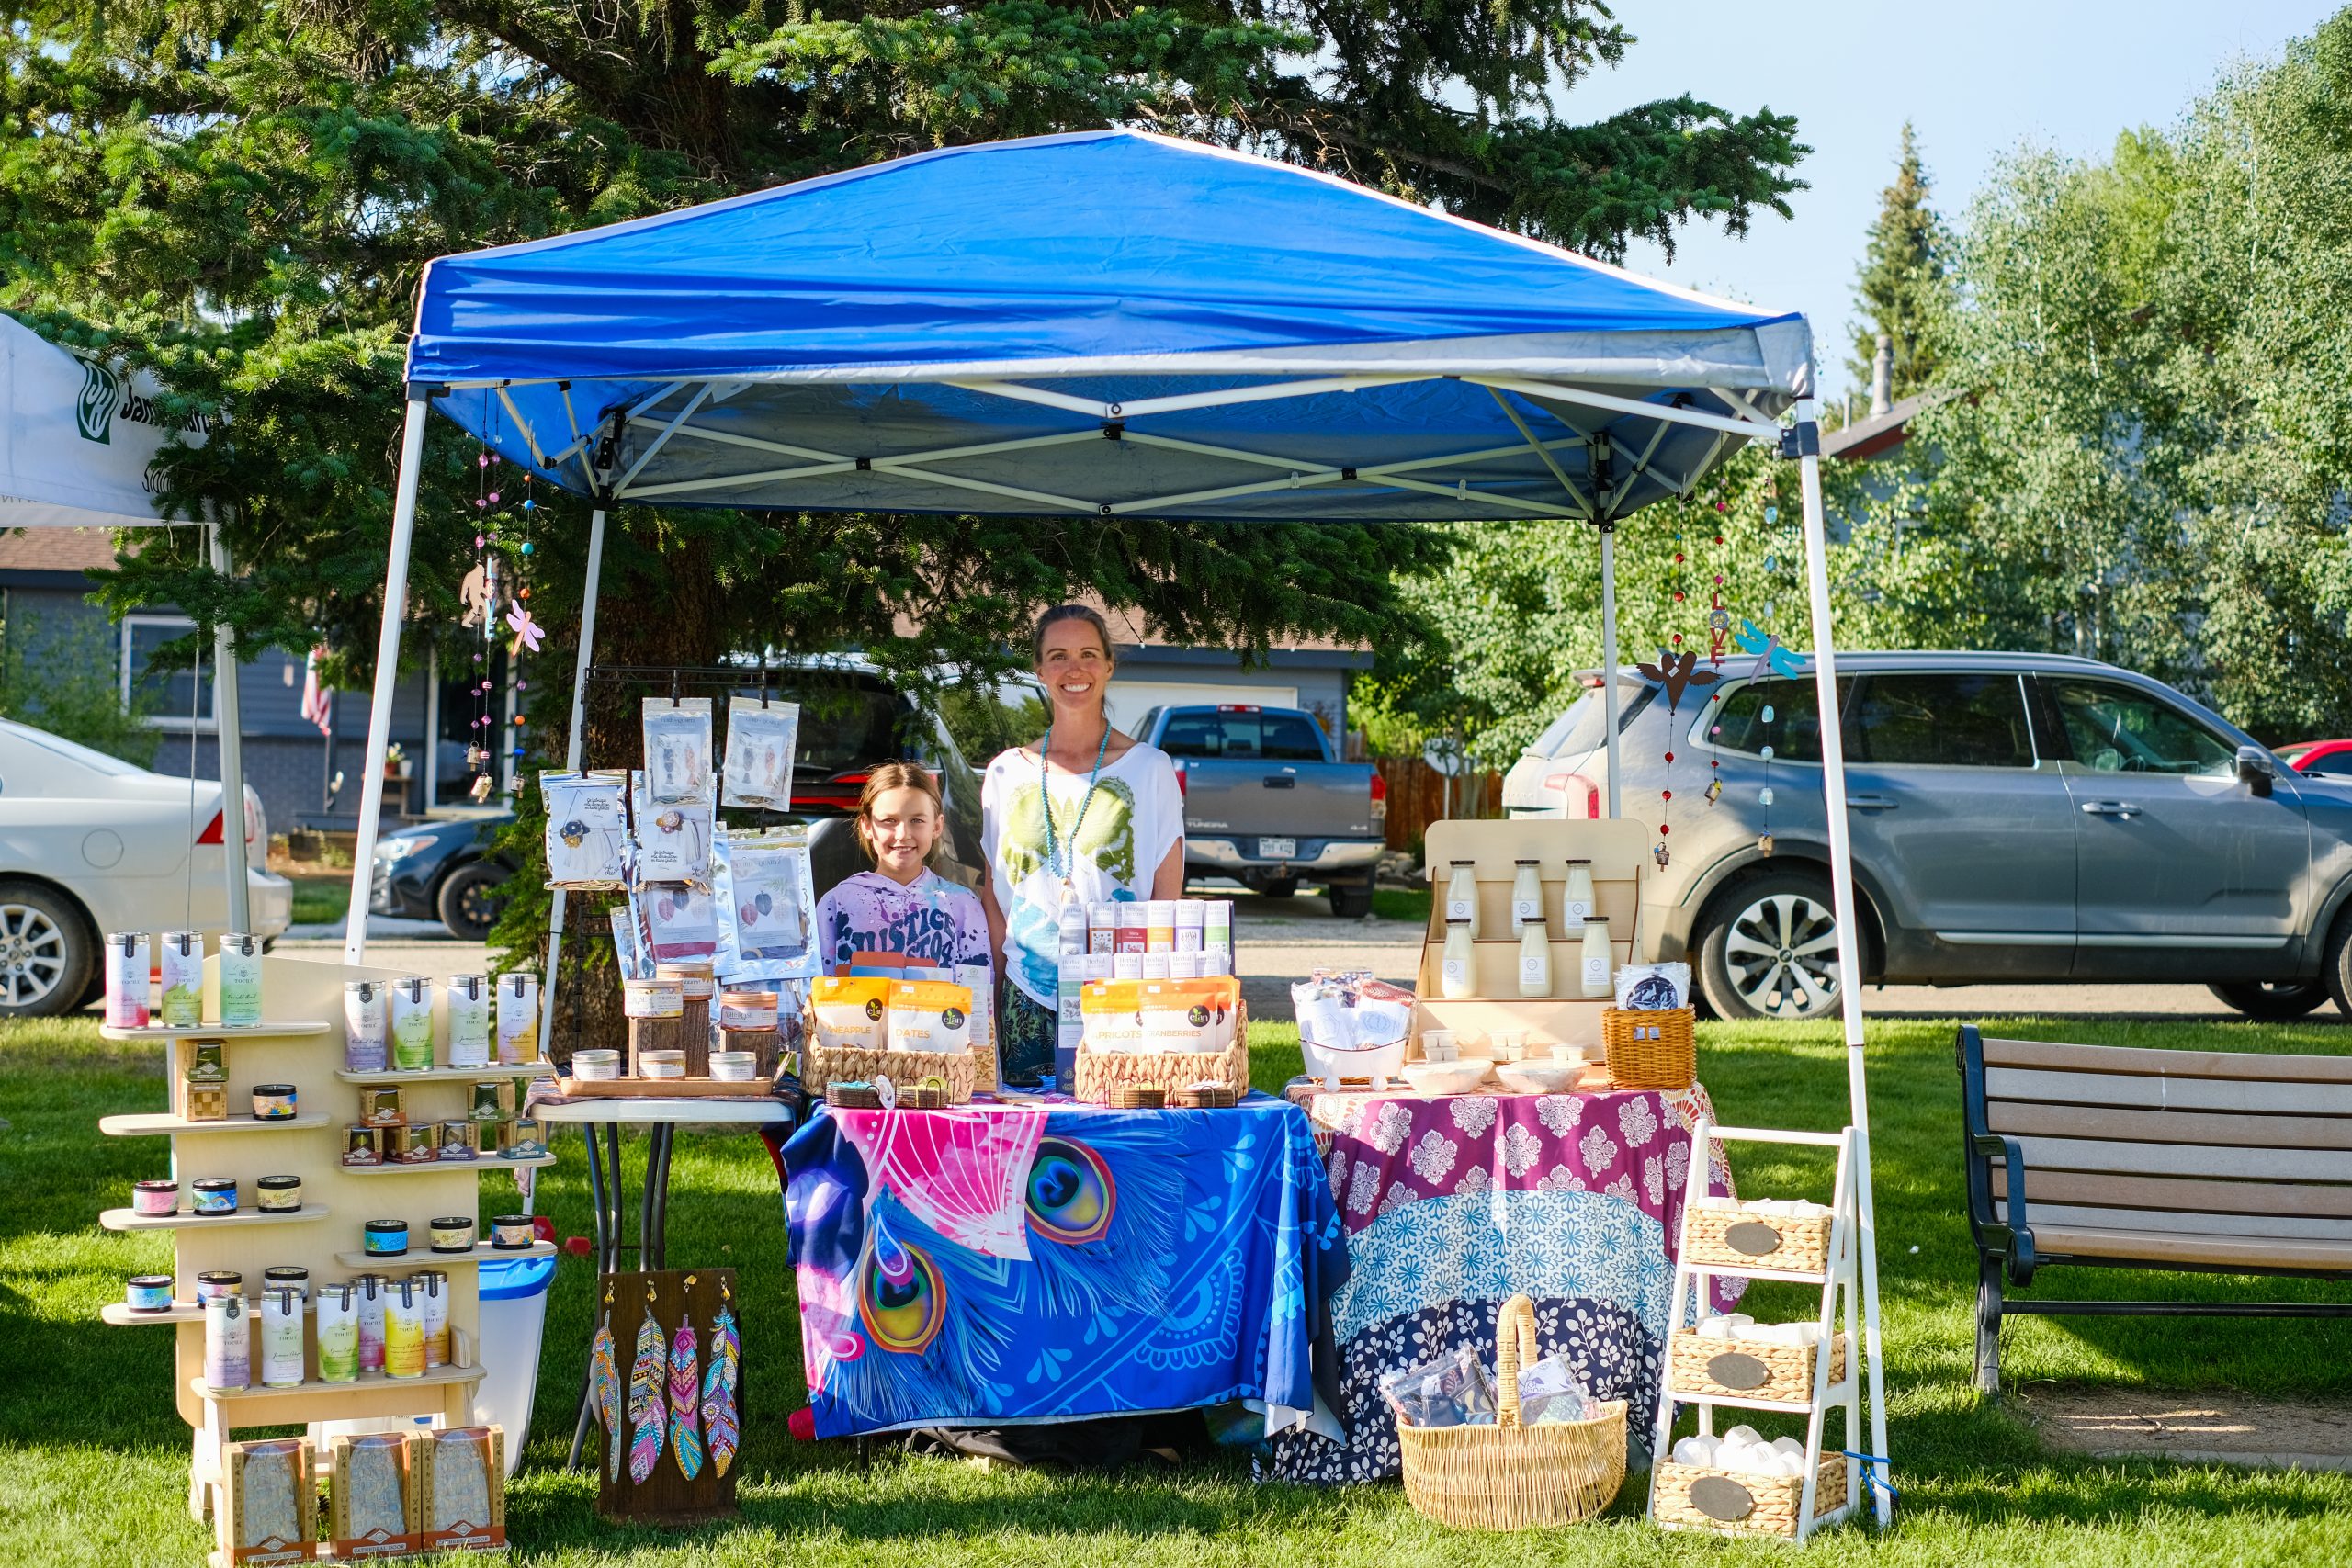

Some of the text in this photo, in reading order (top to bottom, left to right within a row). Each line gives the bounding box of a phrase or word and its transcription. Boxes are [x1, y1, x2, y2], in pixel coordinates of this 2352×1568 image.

[1709, 592, 1729, 663] LOVE
[896, 1028, 930, 1038] DATES
[1093, 1030, 1142, 1039] PRICOTS
[437, 1538, 470, 1546] CATHEDRAL
[353, 1545, 388, 1553] CATHEDRAL
[248, 1551, 300, 1561] CATHEDRAL DOOR
